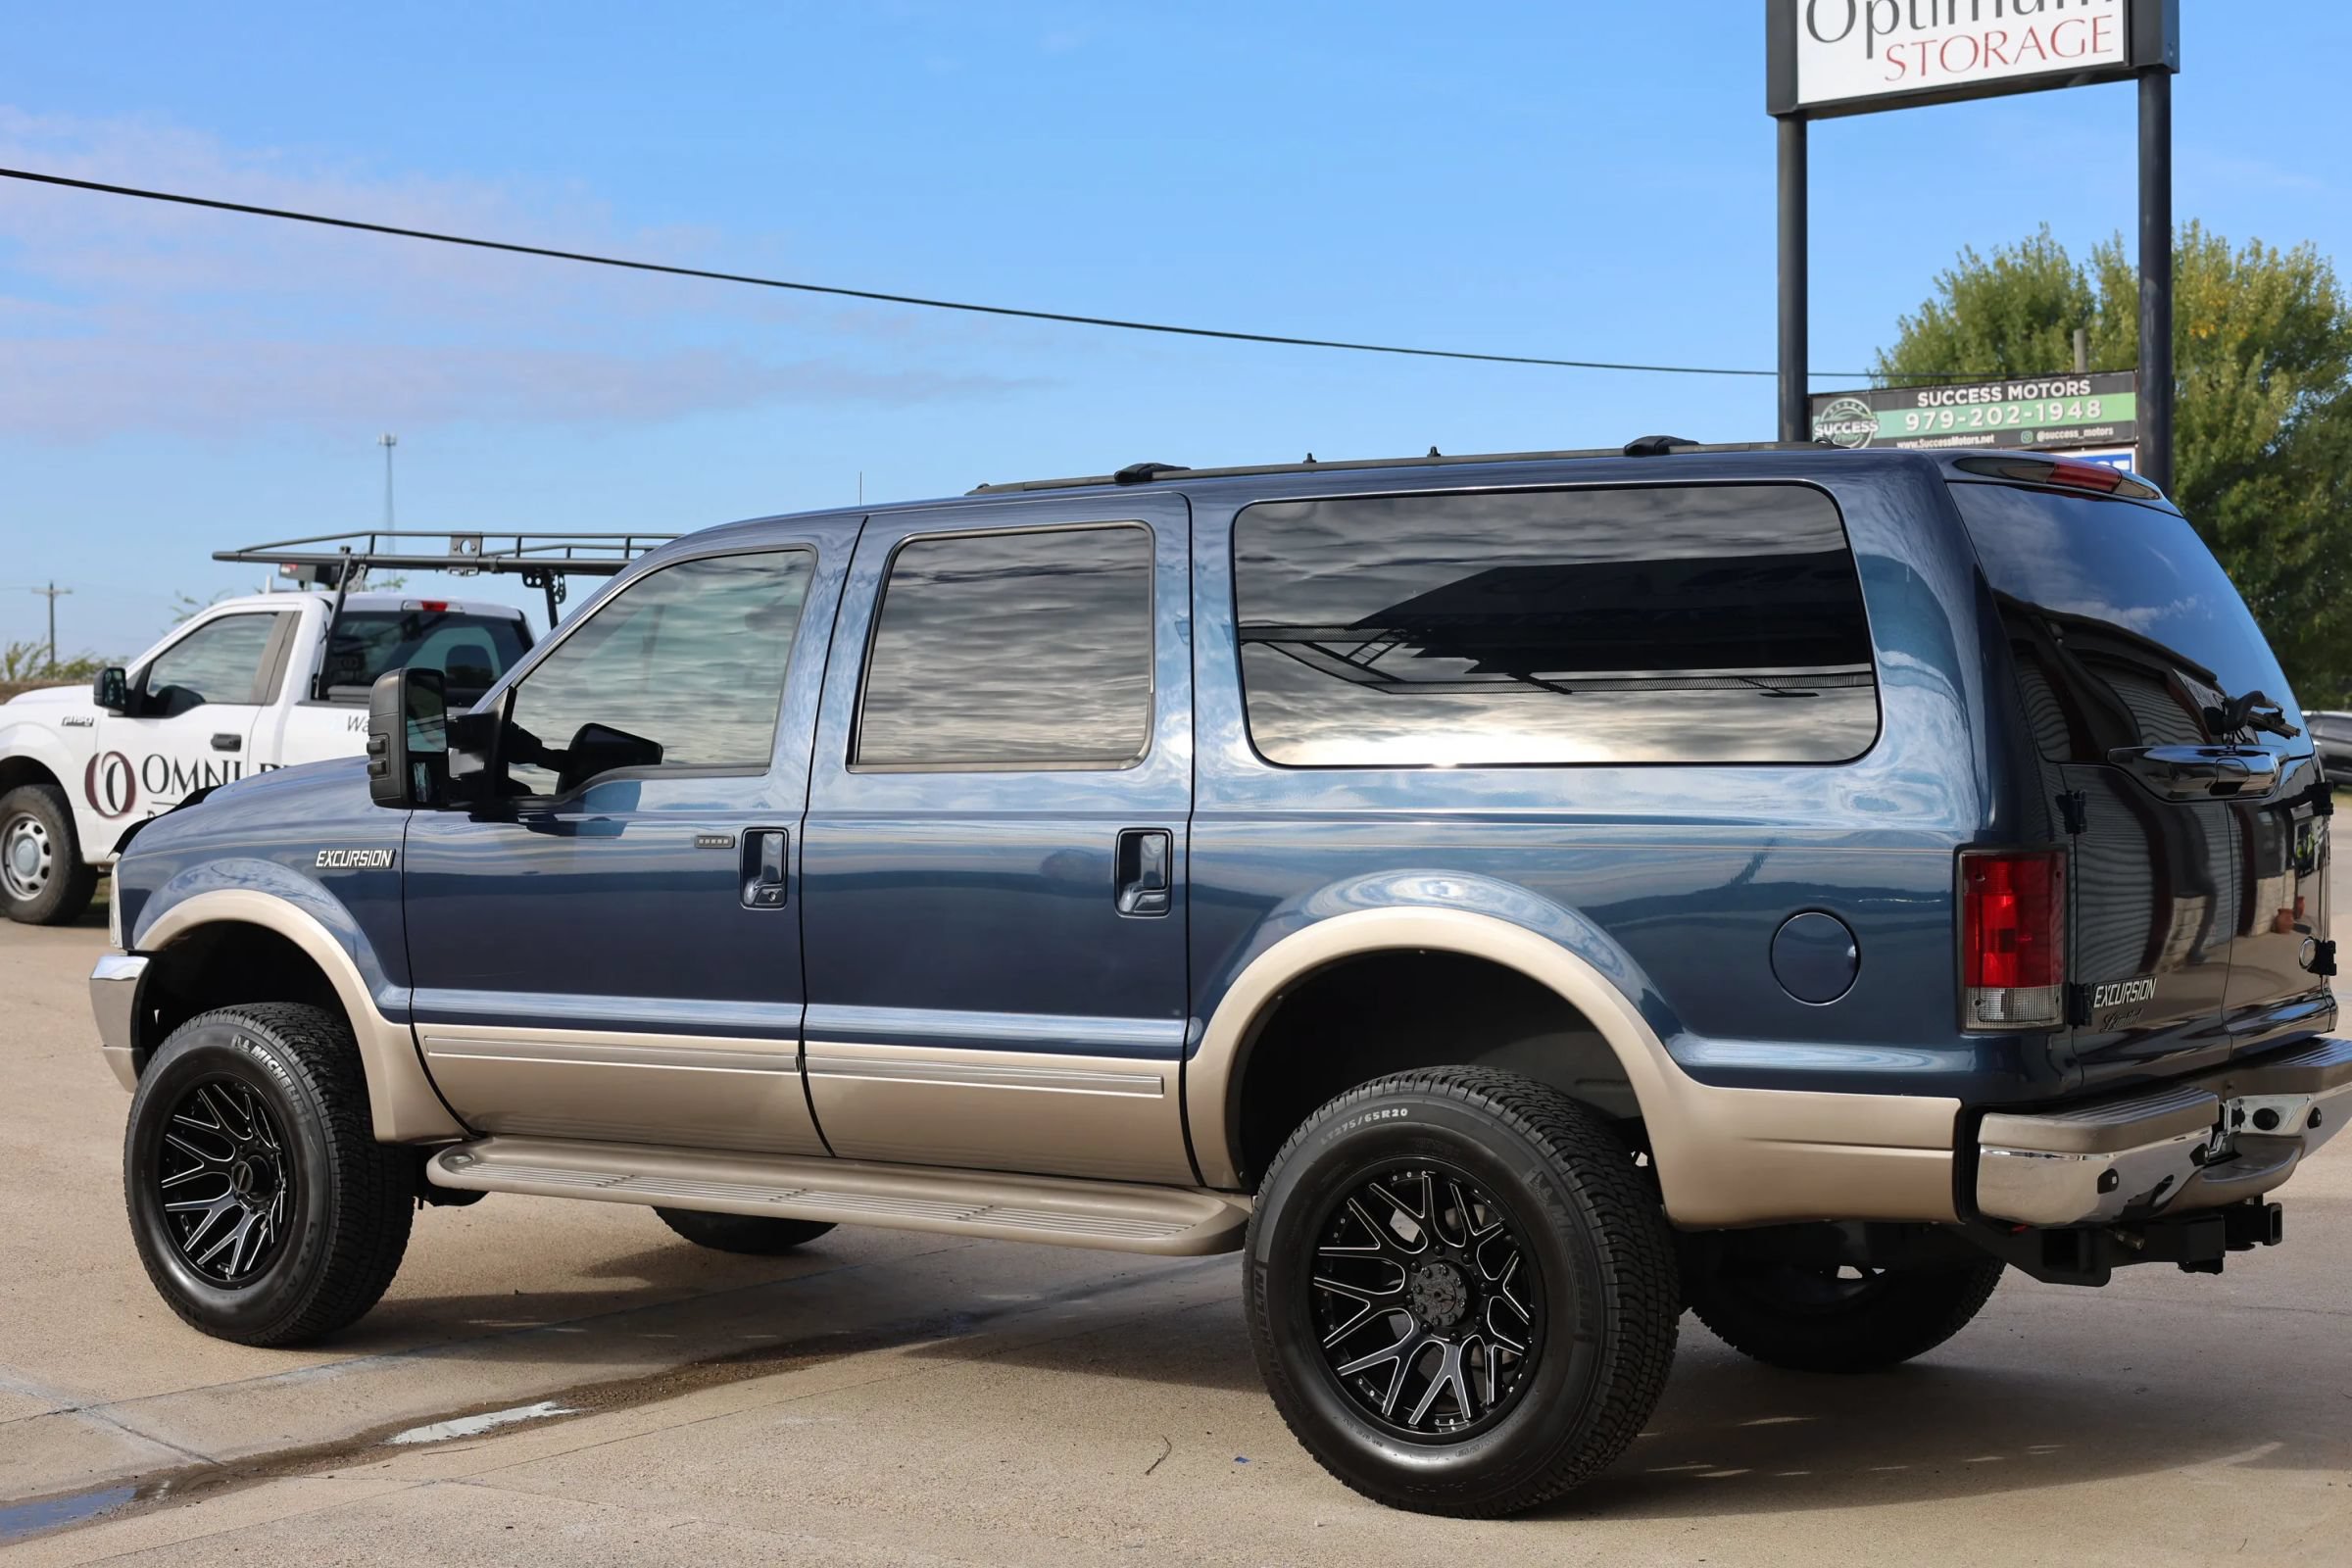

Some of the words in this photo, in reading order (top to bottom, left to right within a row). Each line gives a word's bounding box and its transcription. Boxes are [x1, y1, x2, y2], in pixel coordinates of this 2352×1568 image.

[1885, 14, 2113, 81] STORAGE
[1917, 383, 2002, 408] SUCCESS
[2008, 378, 2091, 402] MOTORS
[1814, 418, 1880, 437] SUCCESS
[1905, 399, 2102, 433] 979-202-1948
[1896, 433, 1995, 450] www.SuccessMotors.net
[2036, 427, 2114, 443] @success_motors
[316, 849, 394, 868] EXCURSION
[2093, 977, 2157, 1009] EXCURSION
